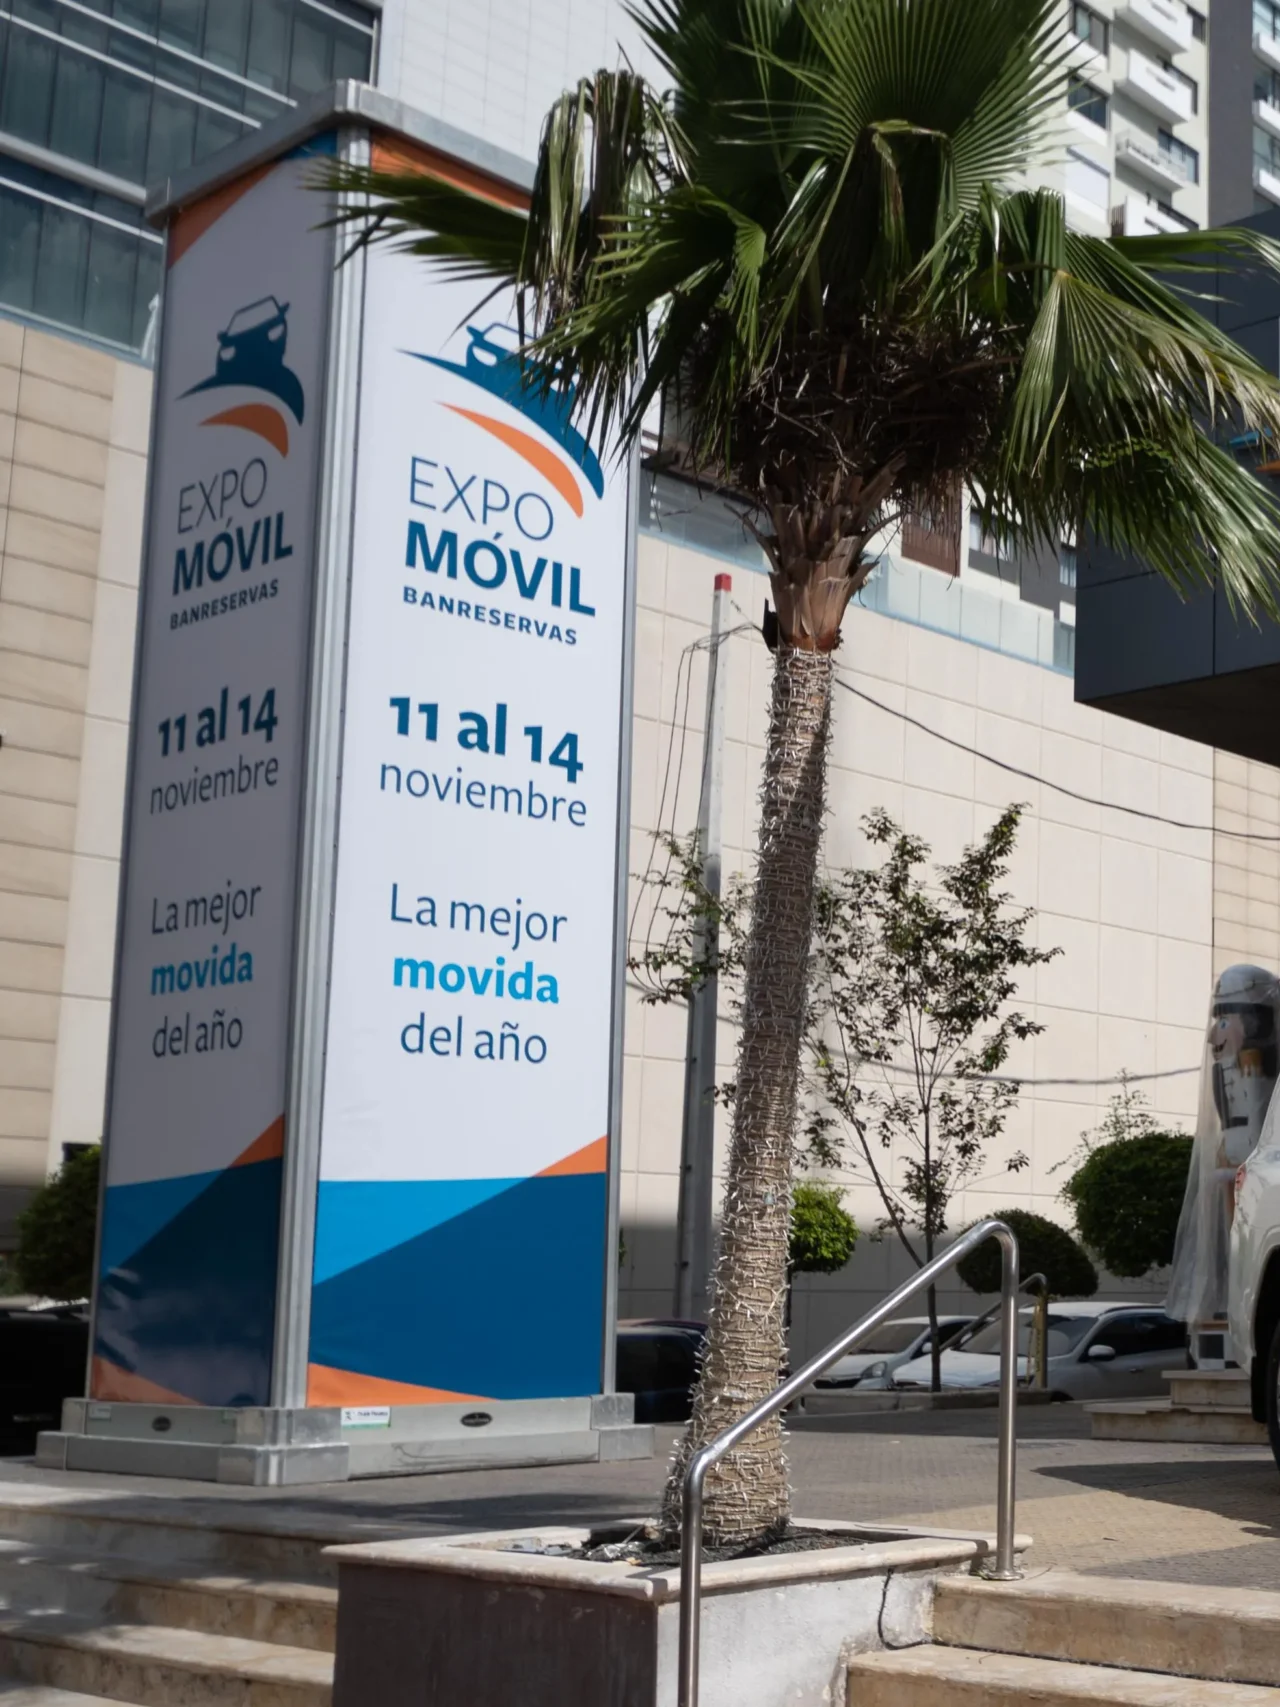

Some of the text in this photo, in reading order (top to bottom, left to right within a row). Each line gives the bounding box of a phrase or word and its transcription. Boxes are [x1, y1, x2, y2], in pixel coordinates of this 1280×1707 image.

[177, 457, 268, 535] EXPO
[409, 455, 555, 542] EXPO
[171, 510, 294, 597] MÓVIL
[404, 518, 597, 618] MÓVIL
[169, 577, 279, 631] BANRESERVAS
[402, 584, 579, 647] BANRESERVAS
[157, 685, 279, 758] 11 al 14
[388, 695, 585, 785] 11 al 14
[149, 754, 279, 815] noviembre
[379, 762, 588, 828] noviembre
[151, 879, 263, 936] La mejor
[390, 882, 569, 952] La mejor
[149, 941, 254, 997] movida
[392, 955, 560, 1005] movida
[151, 1008, 244, 1059] del año
[399, 1011, 548, 1065] del año
